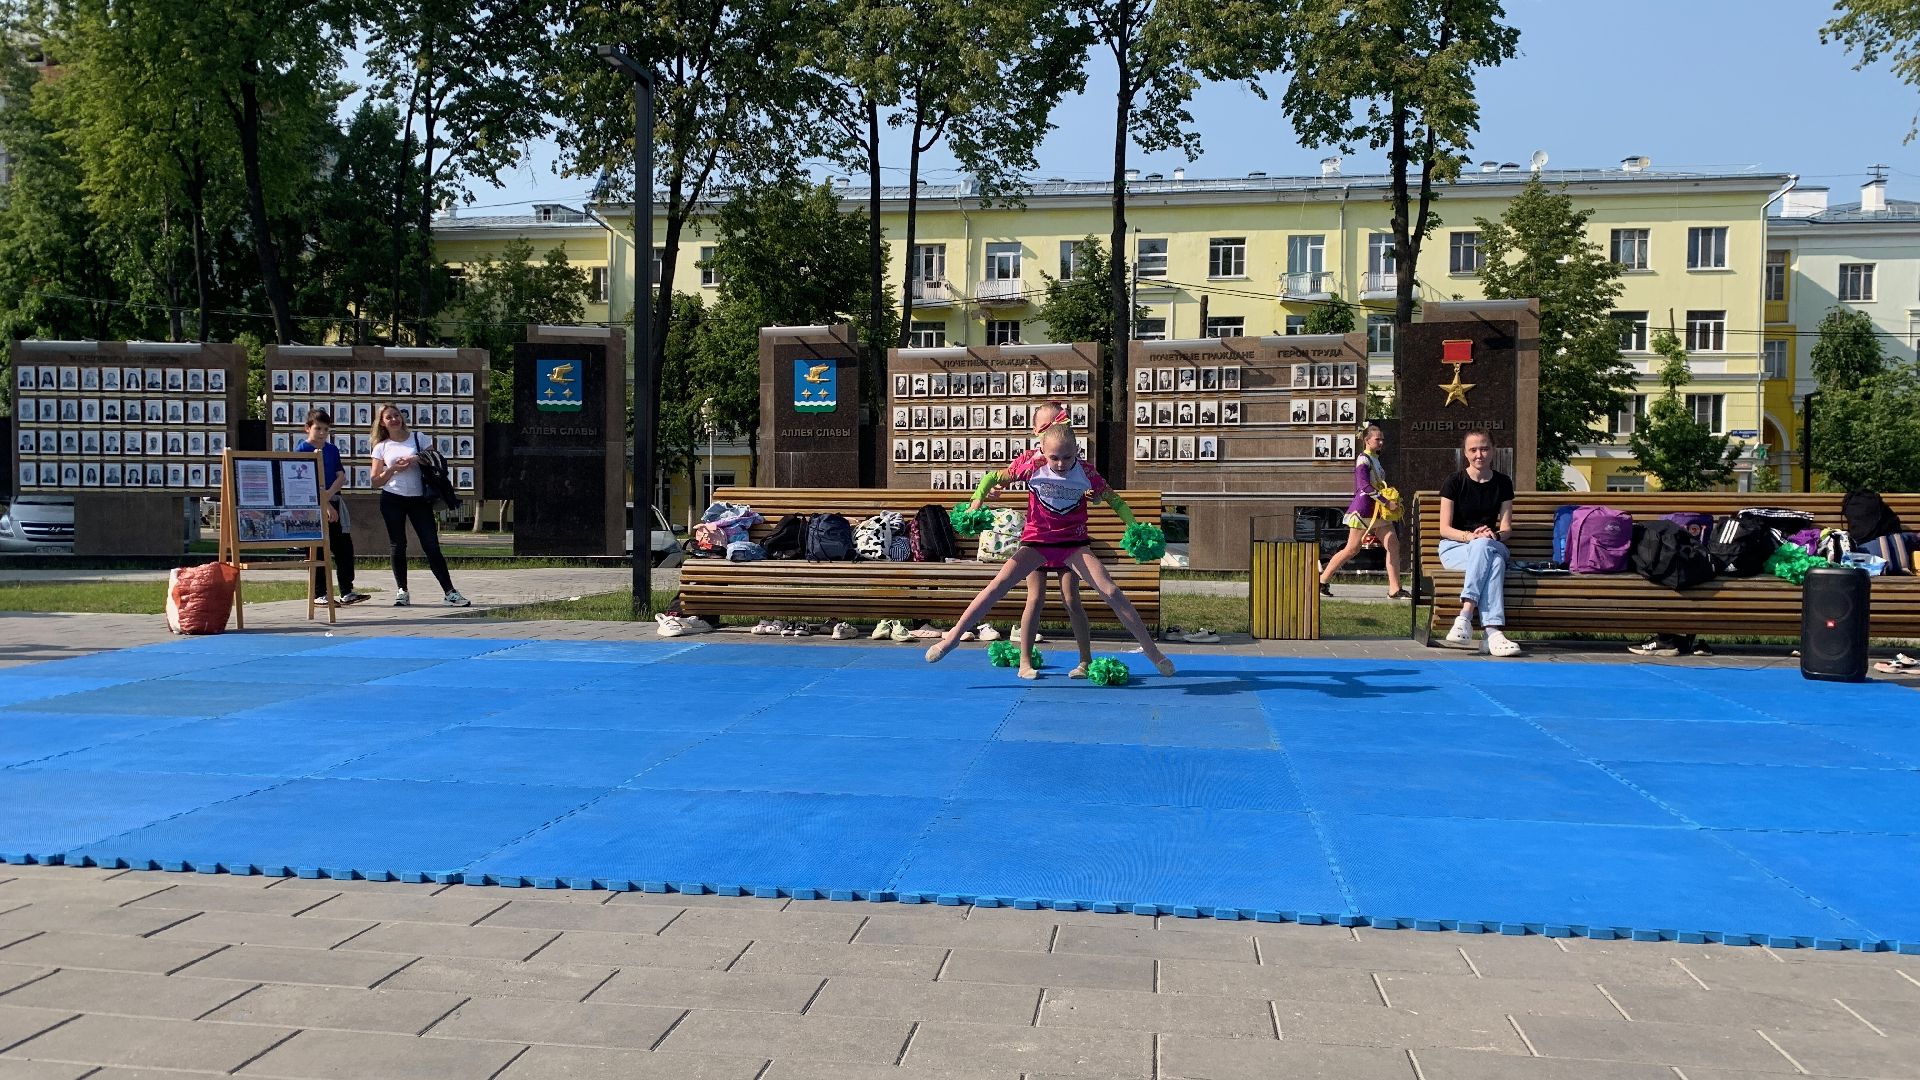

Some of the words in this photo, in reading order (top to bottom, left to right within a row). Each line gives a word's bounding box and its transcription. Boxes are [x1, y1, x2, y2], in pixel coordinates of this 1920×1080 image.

[1201, 350, 1255, 361] ГРАЖДАНЕ
[1310, 348, 1344, 358] ТРУДА
[990, 357, 1038, 367] ГРАЖДАНЕ
[1410, 420, 1454, 430] АЛЛЕЯ
[1457, 419, 1504, 430] СЛАВЫ
[520, 426, 557, 436] АЛЛЕЯ
[559, 427, 597, 436] СЛАВЫ
[781, 428, 813, 437] АЛЛЕЯ
[816, 428, 851, 437] СЛАВЫ
